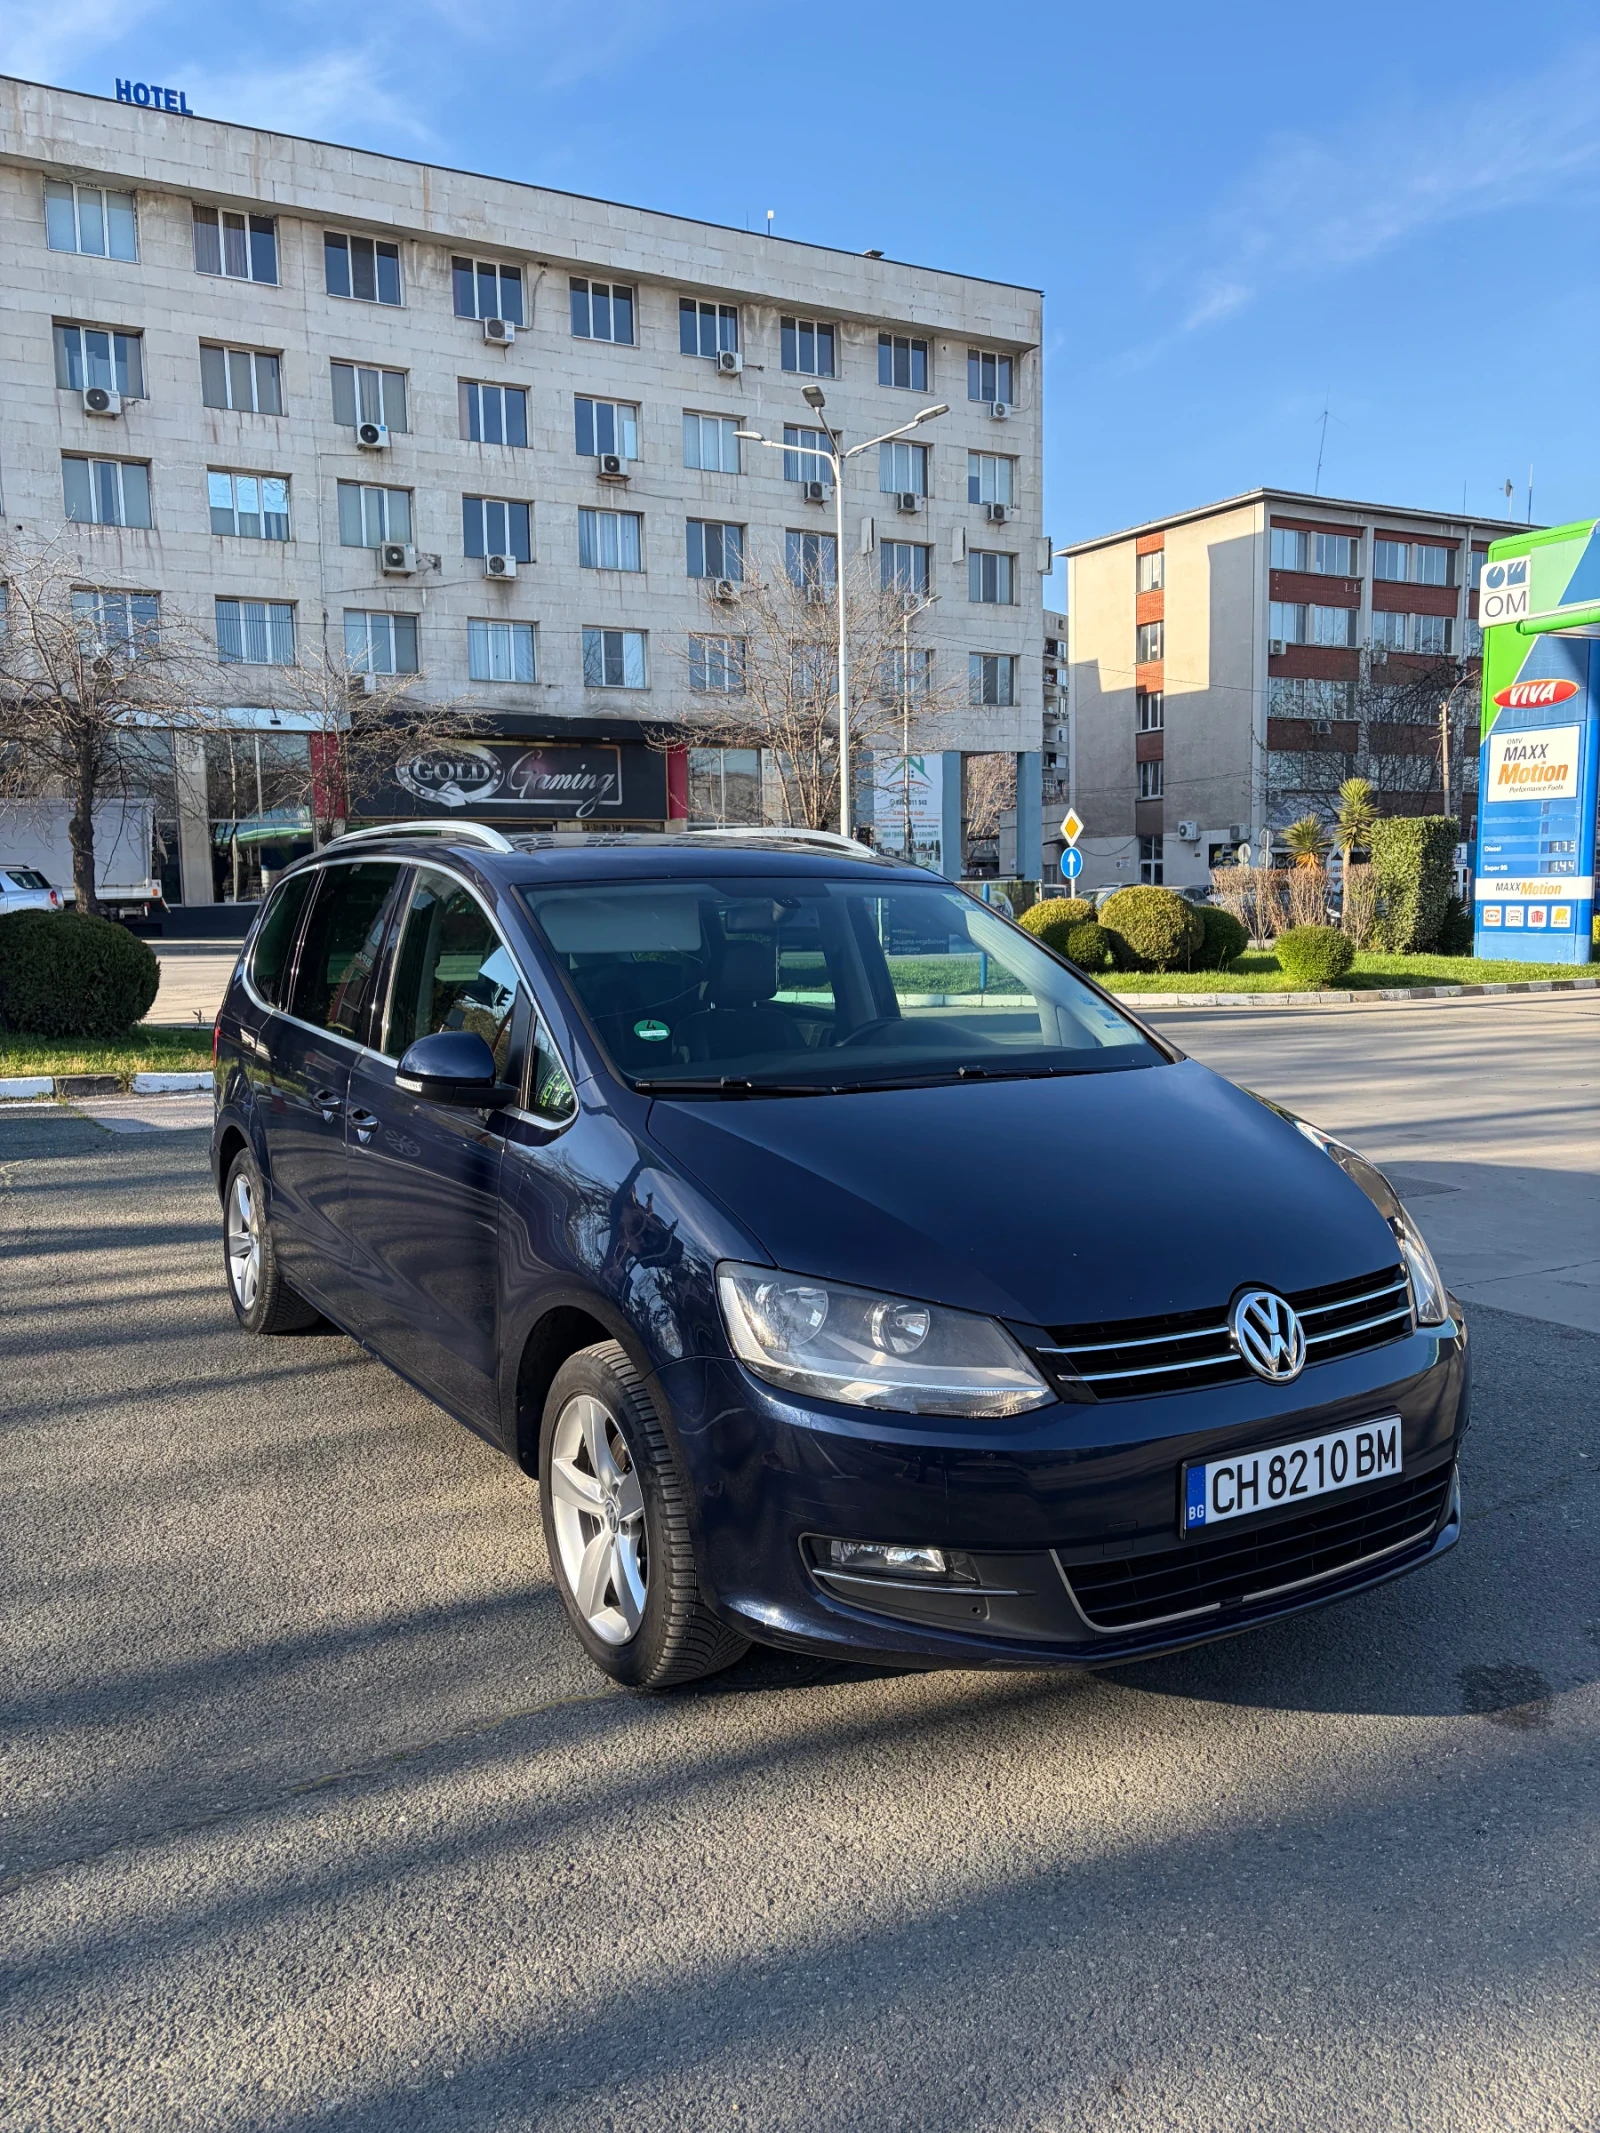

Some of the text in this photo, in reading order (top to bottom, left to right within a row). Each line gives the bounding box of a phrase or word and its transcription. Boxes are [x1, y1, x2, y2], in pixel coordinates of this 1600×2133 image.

[115, 77, 193, 116] HOTEL
[1485, 590, 1527, 618] OM
[1509, 682, 1558, 706] VIVA
[1503, 743, 1549, 762] MAXX
[412, 750, 615, 818] GOLD Gaming
[1497, 761, 1569, 785] Motion
[1509, 785, 1547, 793] Performance
[1484, 864, 1500, 872] Super
[1554, 860, 1575, 872] 1,44
[646, 1020, 657, 1030] 4
[1212, 1425, 1397, 1514] CH 8210 BM
[1188, 1504, 1204, 1520] BG
